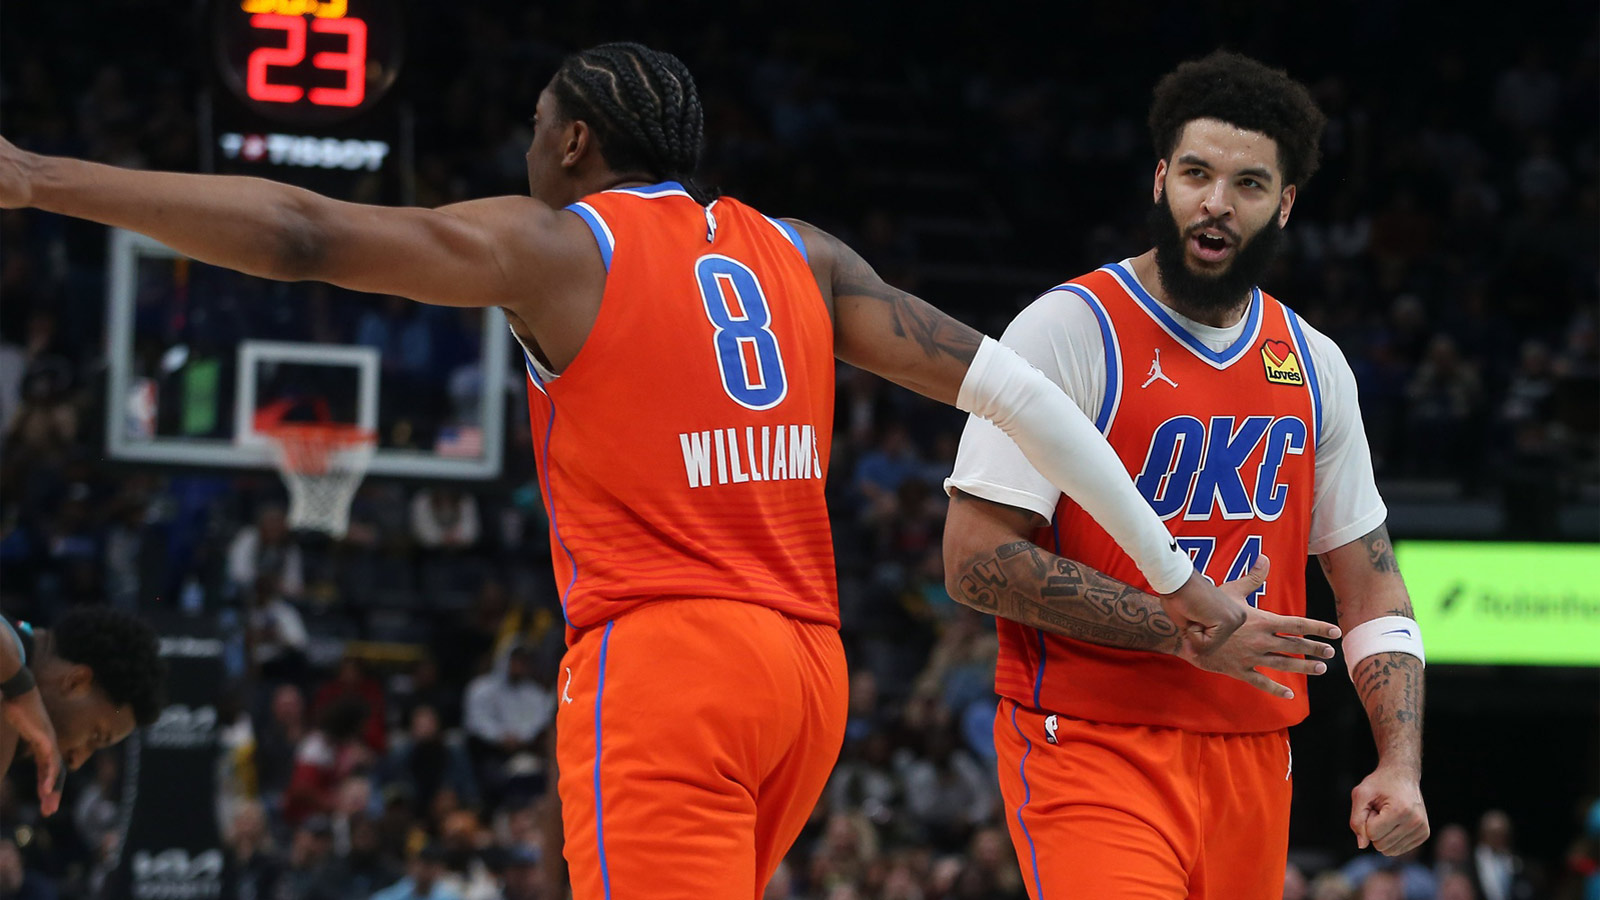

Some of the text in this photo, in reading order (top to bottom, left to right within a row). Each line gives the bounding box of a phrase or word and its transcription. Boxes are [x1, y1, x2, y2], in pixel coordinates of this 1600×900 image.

[247, 13, 367, 107] 23
[695, 253, 788, 411] 8
[1134, 414, 1308, 522] OKC
